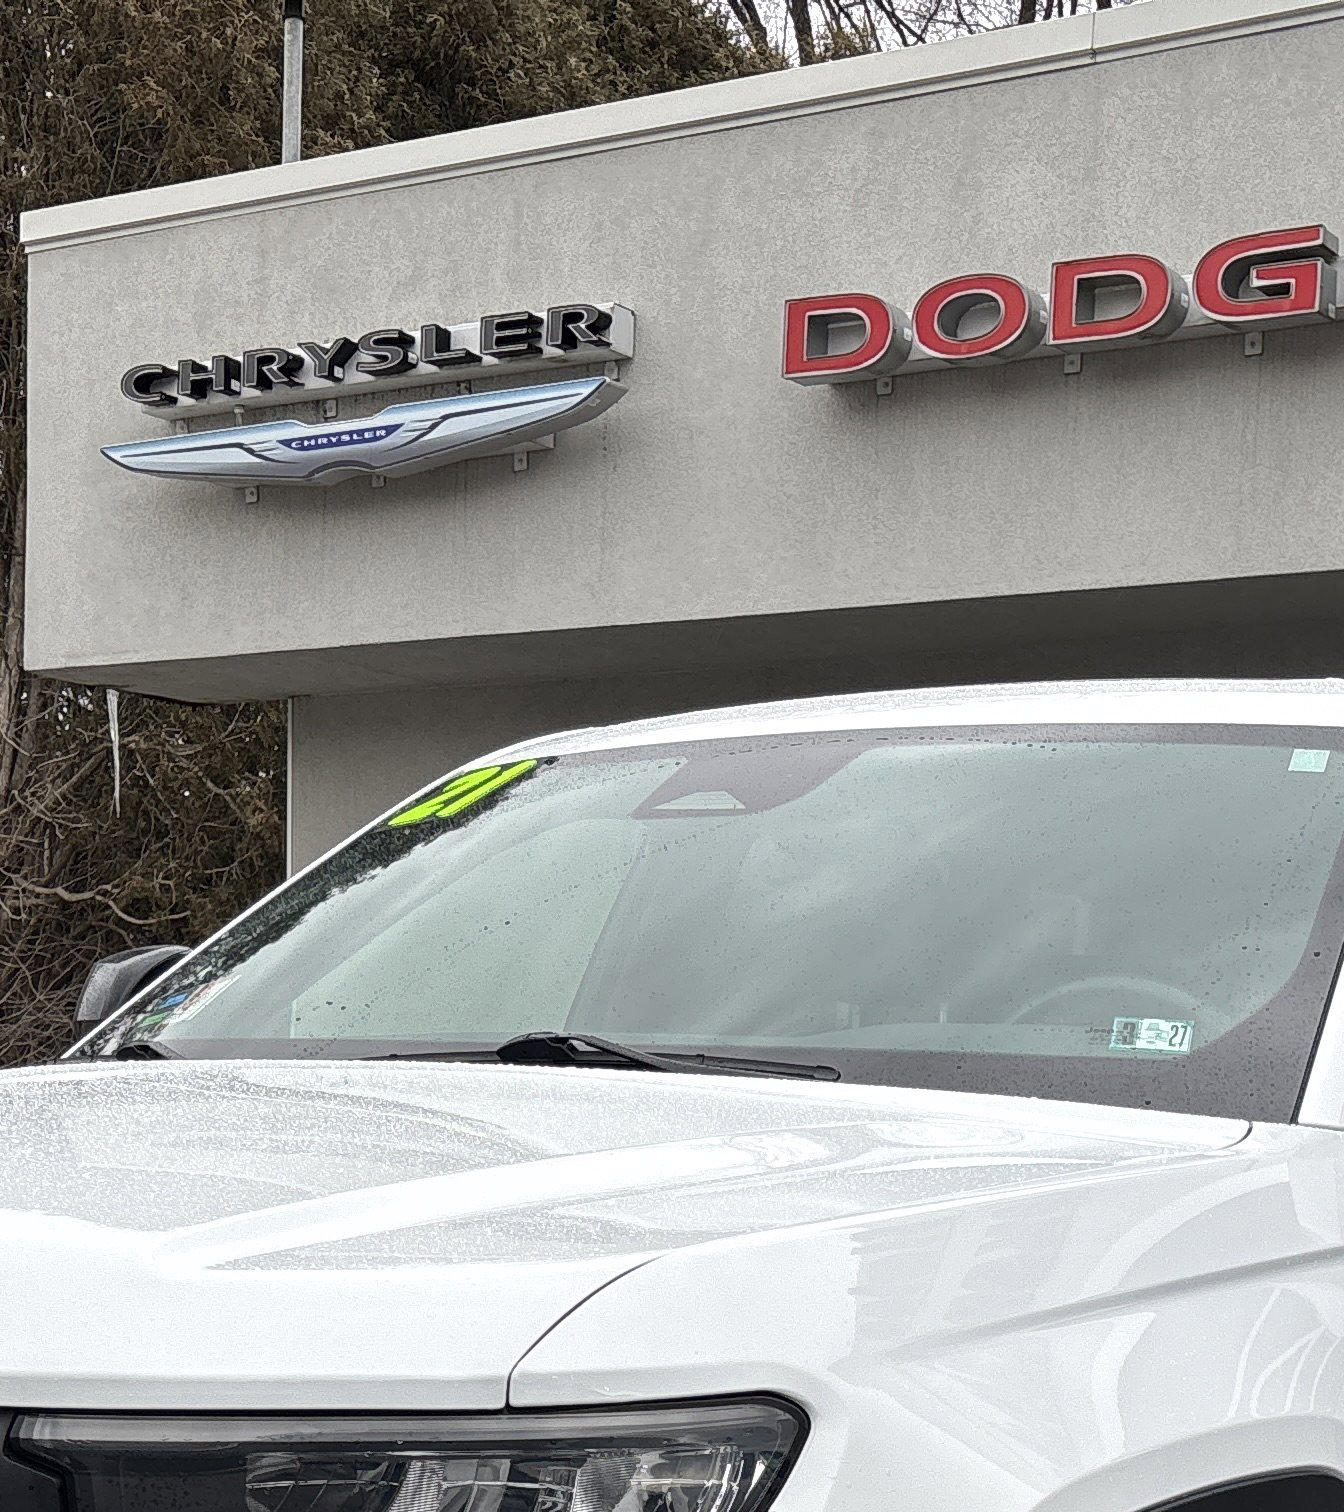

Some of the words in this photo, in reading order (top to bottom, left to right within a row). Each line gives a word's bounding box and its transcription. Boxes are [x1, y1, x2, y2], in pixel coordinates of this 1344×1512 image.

[120, 302, 612, 405] CHRYSLER
[290, 429, 387, 448] CHRYSLER
[1167, 1024, 1188, 1048] 27
